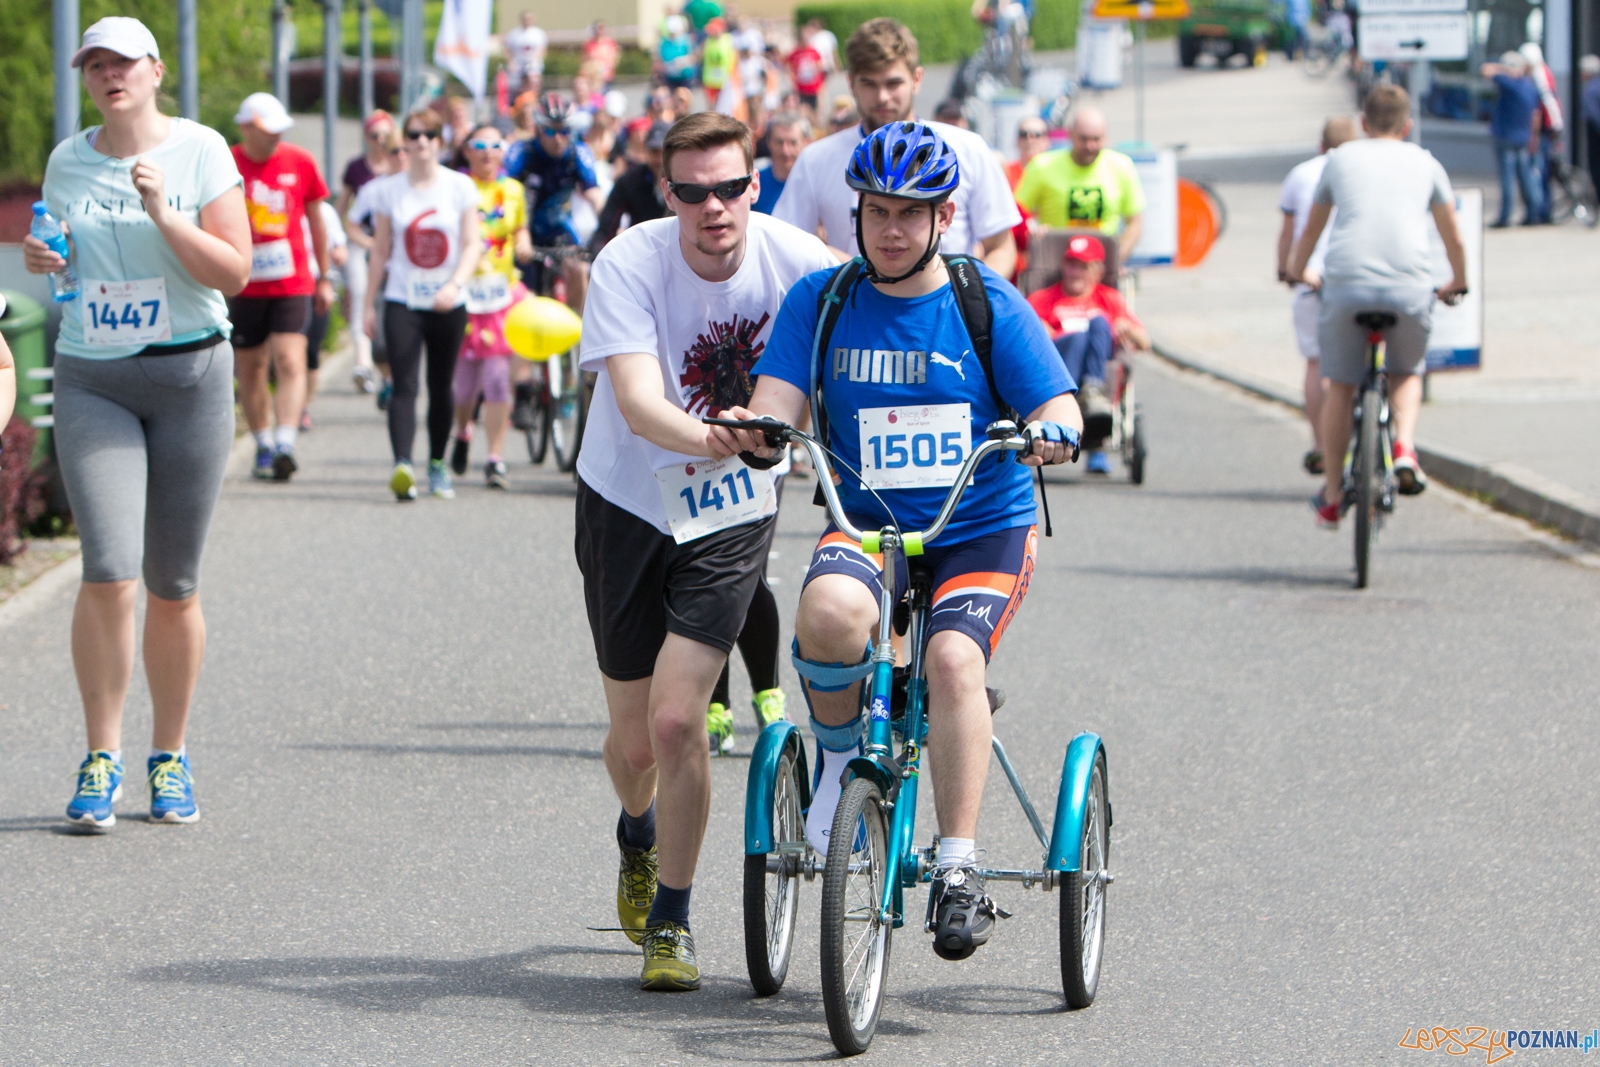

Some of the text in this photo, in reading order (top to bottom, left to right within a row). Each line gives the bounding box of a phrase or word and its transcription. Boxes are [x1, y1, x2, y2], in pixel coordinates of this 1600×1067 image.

[88, 299, 161, 330] 1447
[832, 347, 928, 385] PUMA
[868, 431, 964, 470] 1505
[679, 466, 755, 519] 1411
